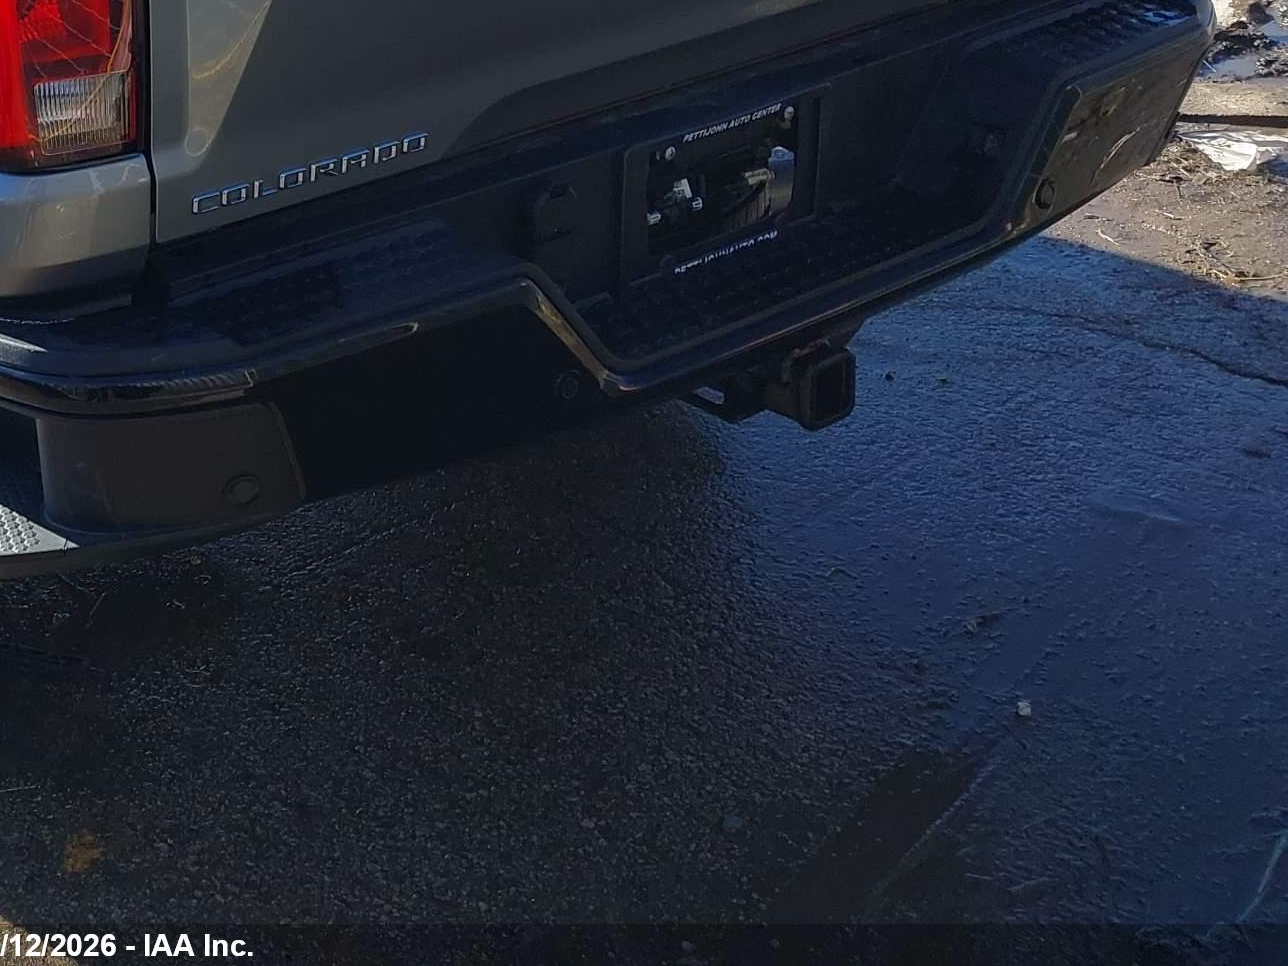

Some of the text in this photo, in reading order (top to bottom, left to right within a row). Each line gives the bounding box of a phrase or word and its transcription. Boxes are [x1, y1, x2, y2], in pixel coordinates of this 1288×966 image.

[682, 102, 783, 143] PETTIJOHN AUTO CENTER
[191, 131, 432, 215] COLORADO
